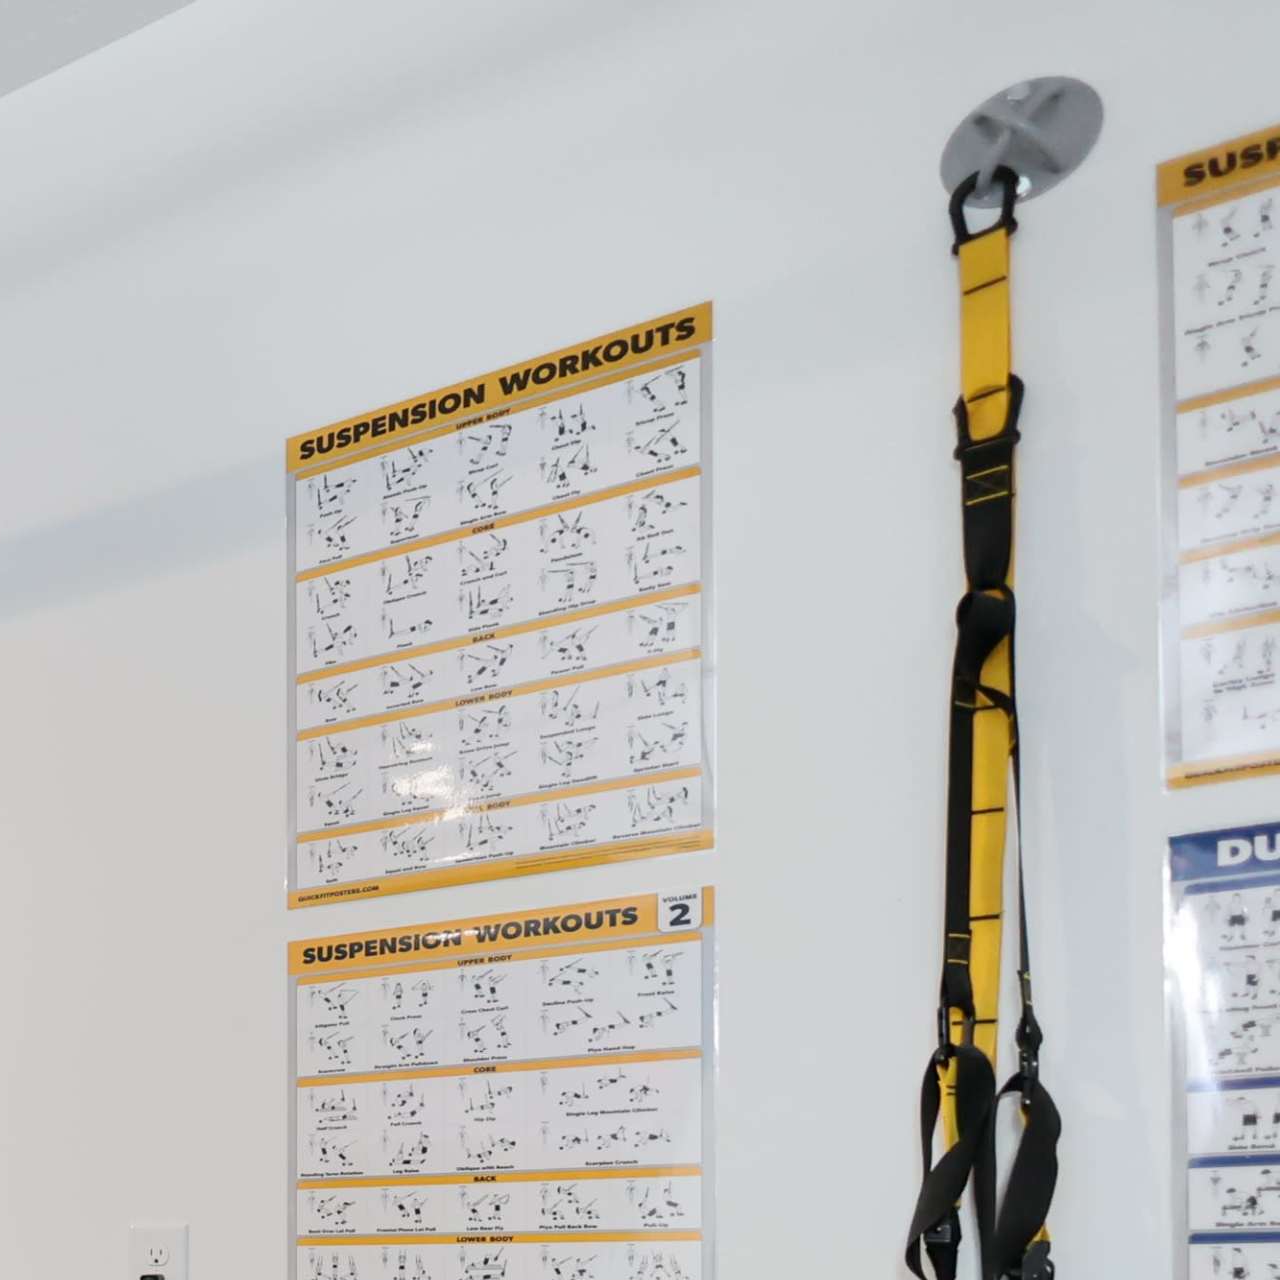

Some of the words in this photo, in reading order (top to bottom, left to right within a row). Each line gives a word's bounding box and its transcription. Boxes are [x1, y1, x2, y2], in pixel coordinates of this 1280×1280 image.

[299, 384, 486, 461] SUSPENSION
[498, 316, 697, 396] WORKOUTS
[455, 417, 486, 431] UPPER
[488, 408, 511, 421] BODY
[471, 522, 494, 534] CORE
[472, 632, 495, 642] BACK
[455, 695, 485, 707] LOWER
[488, 689, 512, 700] BODY
[662, 893, 698, 903] VOLUME
[669, 903, 692, 927] 2
[301, 928, 463, 964] SUSPENSION
[475, 906, 639, 943] WORKOUTS
[456, 957, 484, 966] UPPER
[487, 954, 512, 963] BODY
